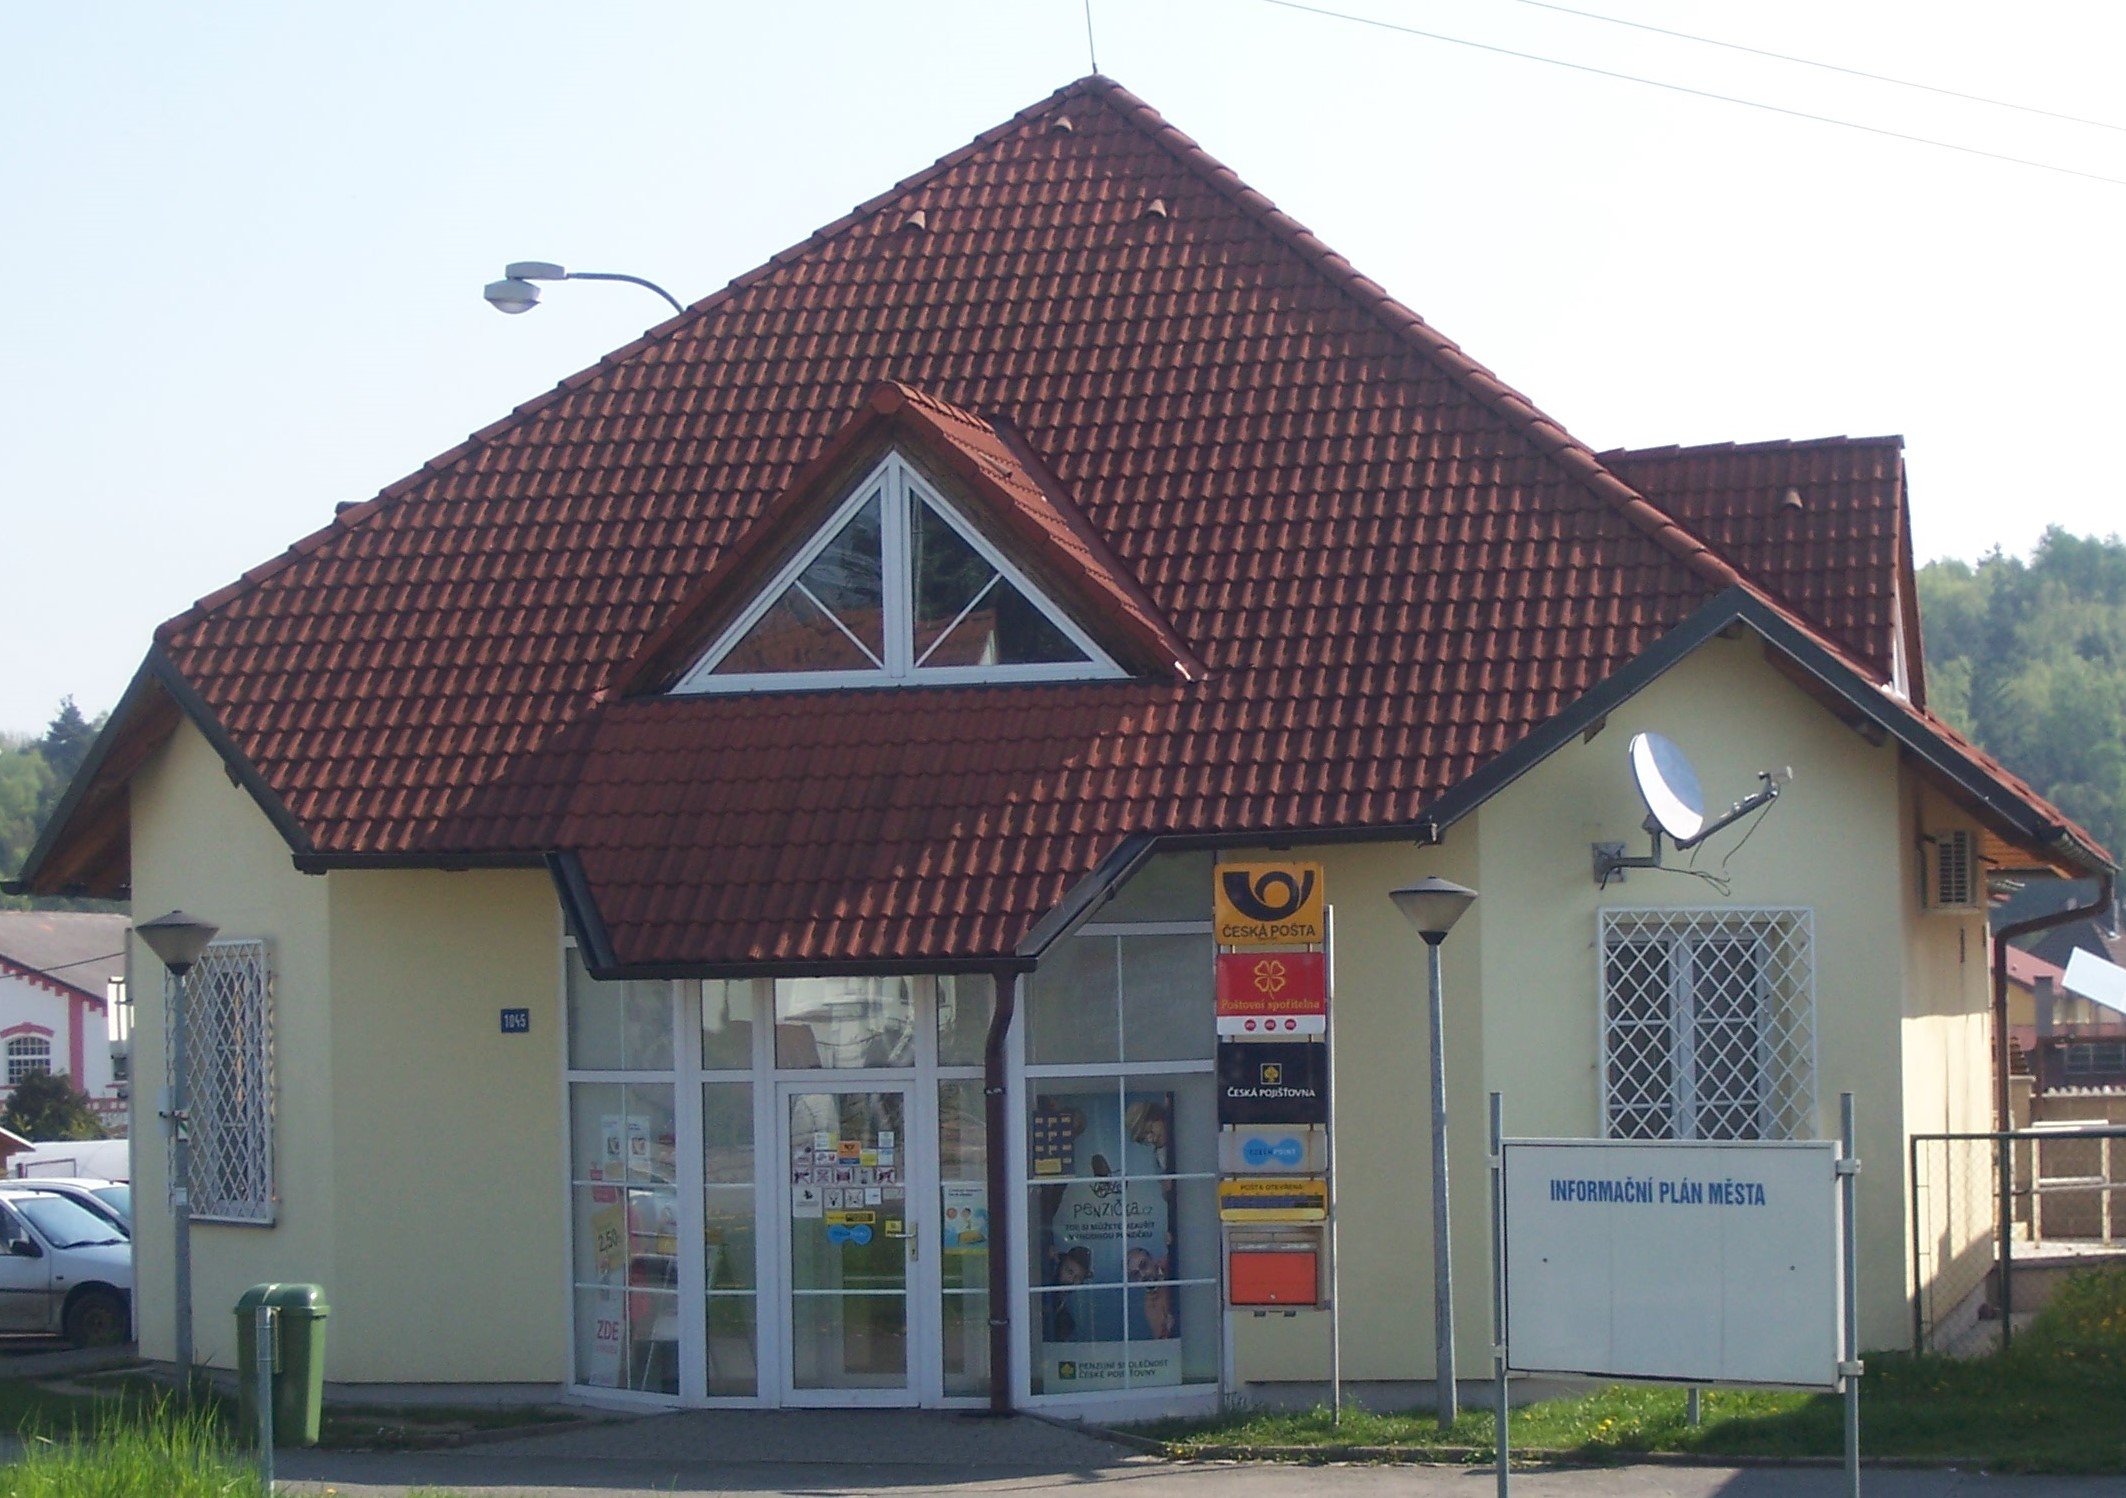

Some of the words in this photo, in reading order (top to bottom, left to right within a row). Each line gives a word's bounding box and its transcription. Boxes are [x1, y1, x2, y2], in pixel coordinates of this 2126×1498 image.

[1222, 923, 1268, 938] ČESKÁ
[1270, 922, 1316, 937] POŠTA
[1221, 999, 1265, 1010] Poštovní
[1267, 998, 1320, 1012] spořitelna
[503, 1013, 527, 1029] 1045
[1227, 1086, 1258, 1098] ČESKÁ
[1550, 1176, 1654, 1204] INFORMAČNÍ
[1658, 1177, 1703, 1205] PLÁN
[1708, 1178, 1767, 1206] MĚSTA
[597, 1320, 620, 1342] ZDE
